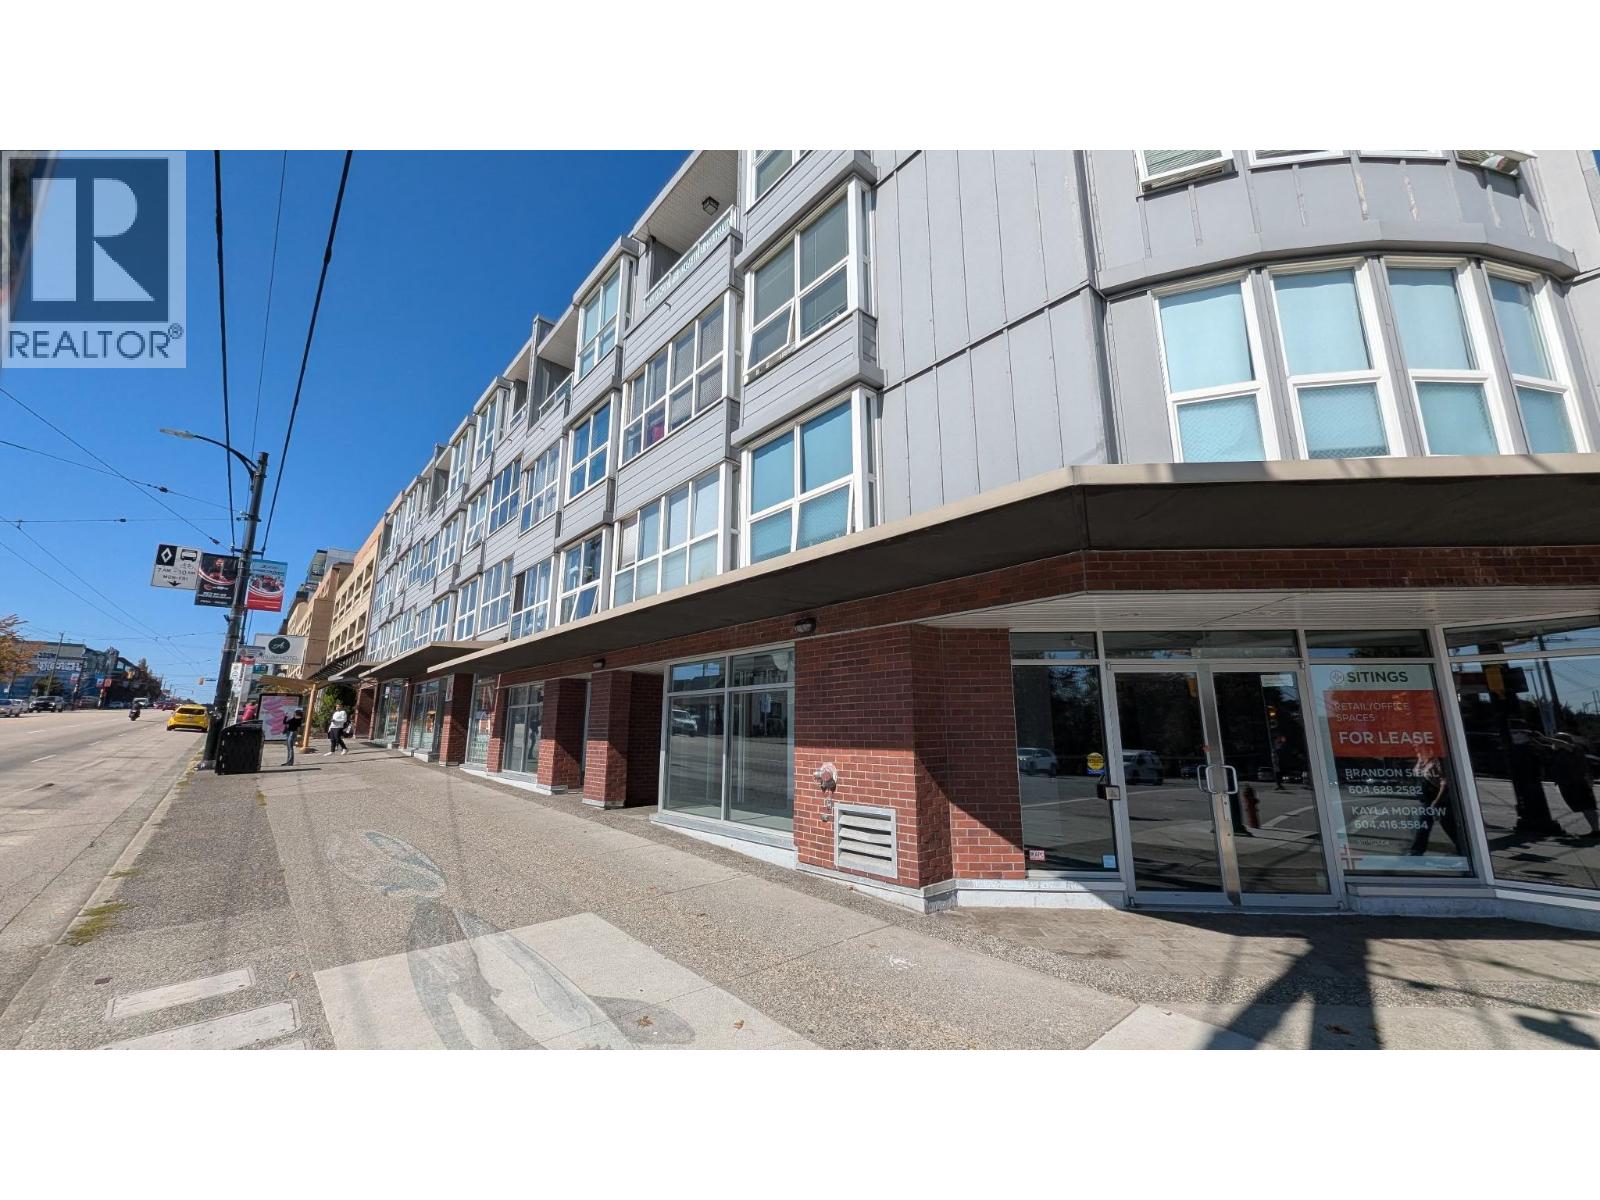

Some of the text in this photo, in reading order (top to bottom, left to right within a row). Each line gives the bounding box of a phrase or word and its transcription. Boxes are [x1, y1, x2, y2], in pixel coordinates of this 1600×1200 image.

[1346, 671, 1409, 683] SITINGS
[1335, 713, 1376, 722] SPACES
[1339, 731, 1434, 744] FOR LEASE
[1345, 768, 1403, 777] BRANDON
[1351, 806, 1447, 816] KAYLA MORROW
